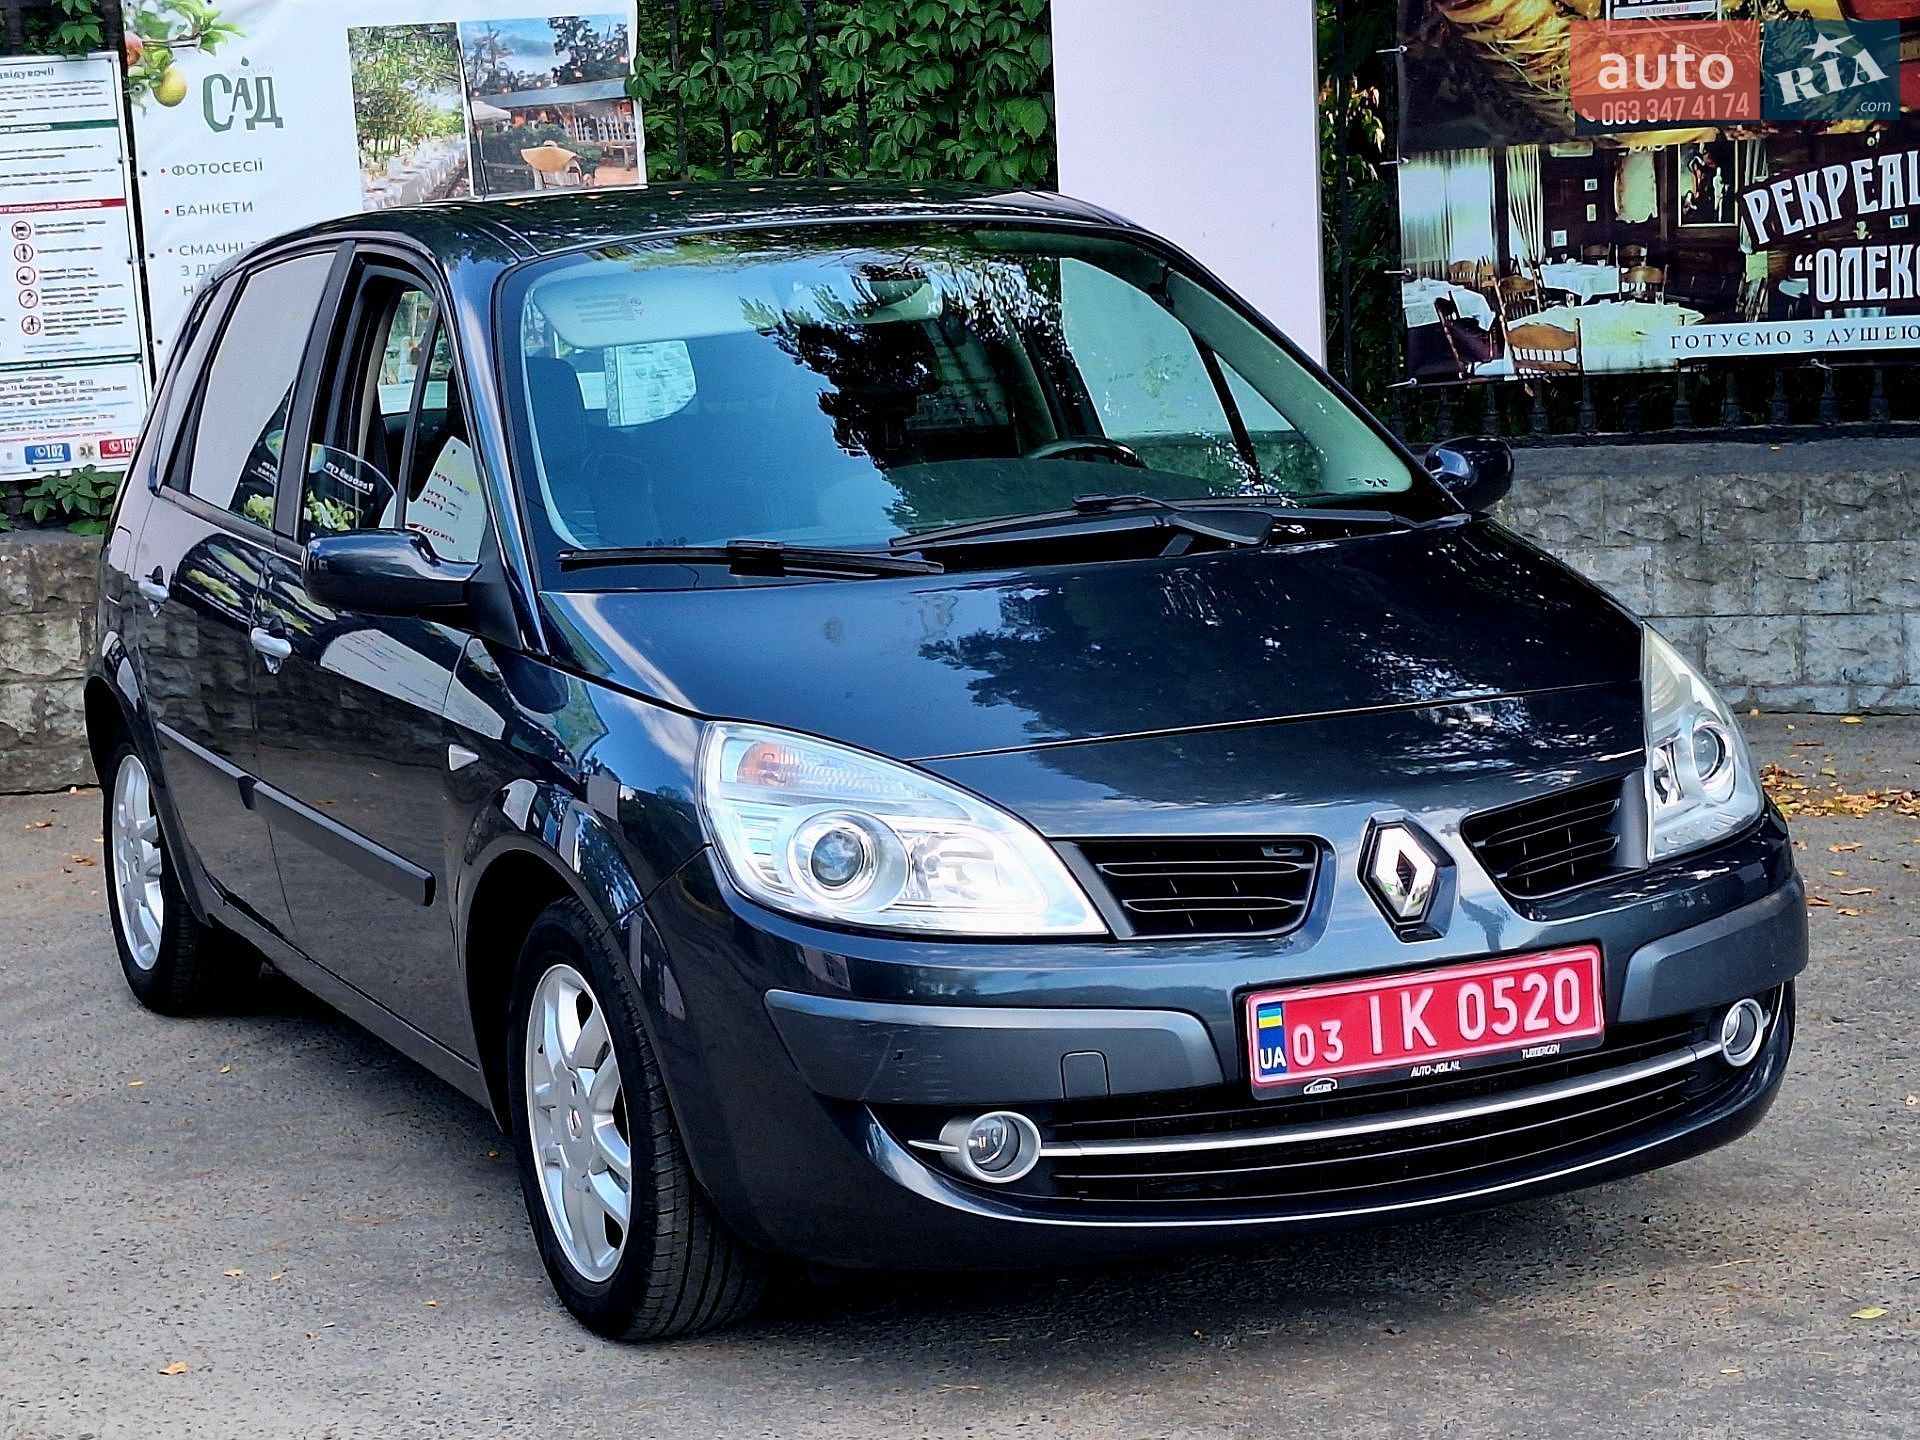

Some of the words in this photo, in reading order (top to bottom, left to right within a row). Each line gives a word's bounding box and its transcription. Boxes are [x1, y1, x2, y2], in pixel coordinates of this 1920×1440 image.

[202, 73, 284, 133] САД
[1601, 100, 1640, 126] 063
[1646, 96, 1686, 123] 347
[1691, 94, 1716, 120] 41
[1722, 92, 1750, 118] 74
[171, 158, 263, 177] ФОТОСЕСІЇ
[176, 201, 254, 217] БАНКЕТИ
[1670, 329, 1792, 350] ГОТУЄМО
[1826, 324, 1920, 346] ДУШЕЮ
[46, 444, 65, 459] 102
[1259, 1046, 1287, 1071] UA
[1292, 1019, 1345, 1068] 03
[1368, 986, 1439, 1056] IK
[1456, 966, 1582, 1042] 0520
